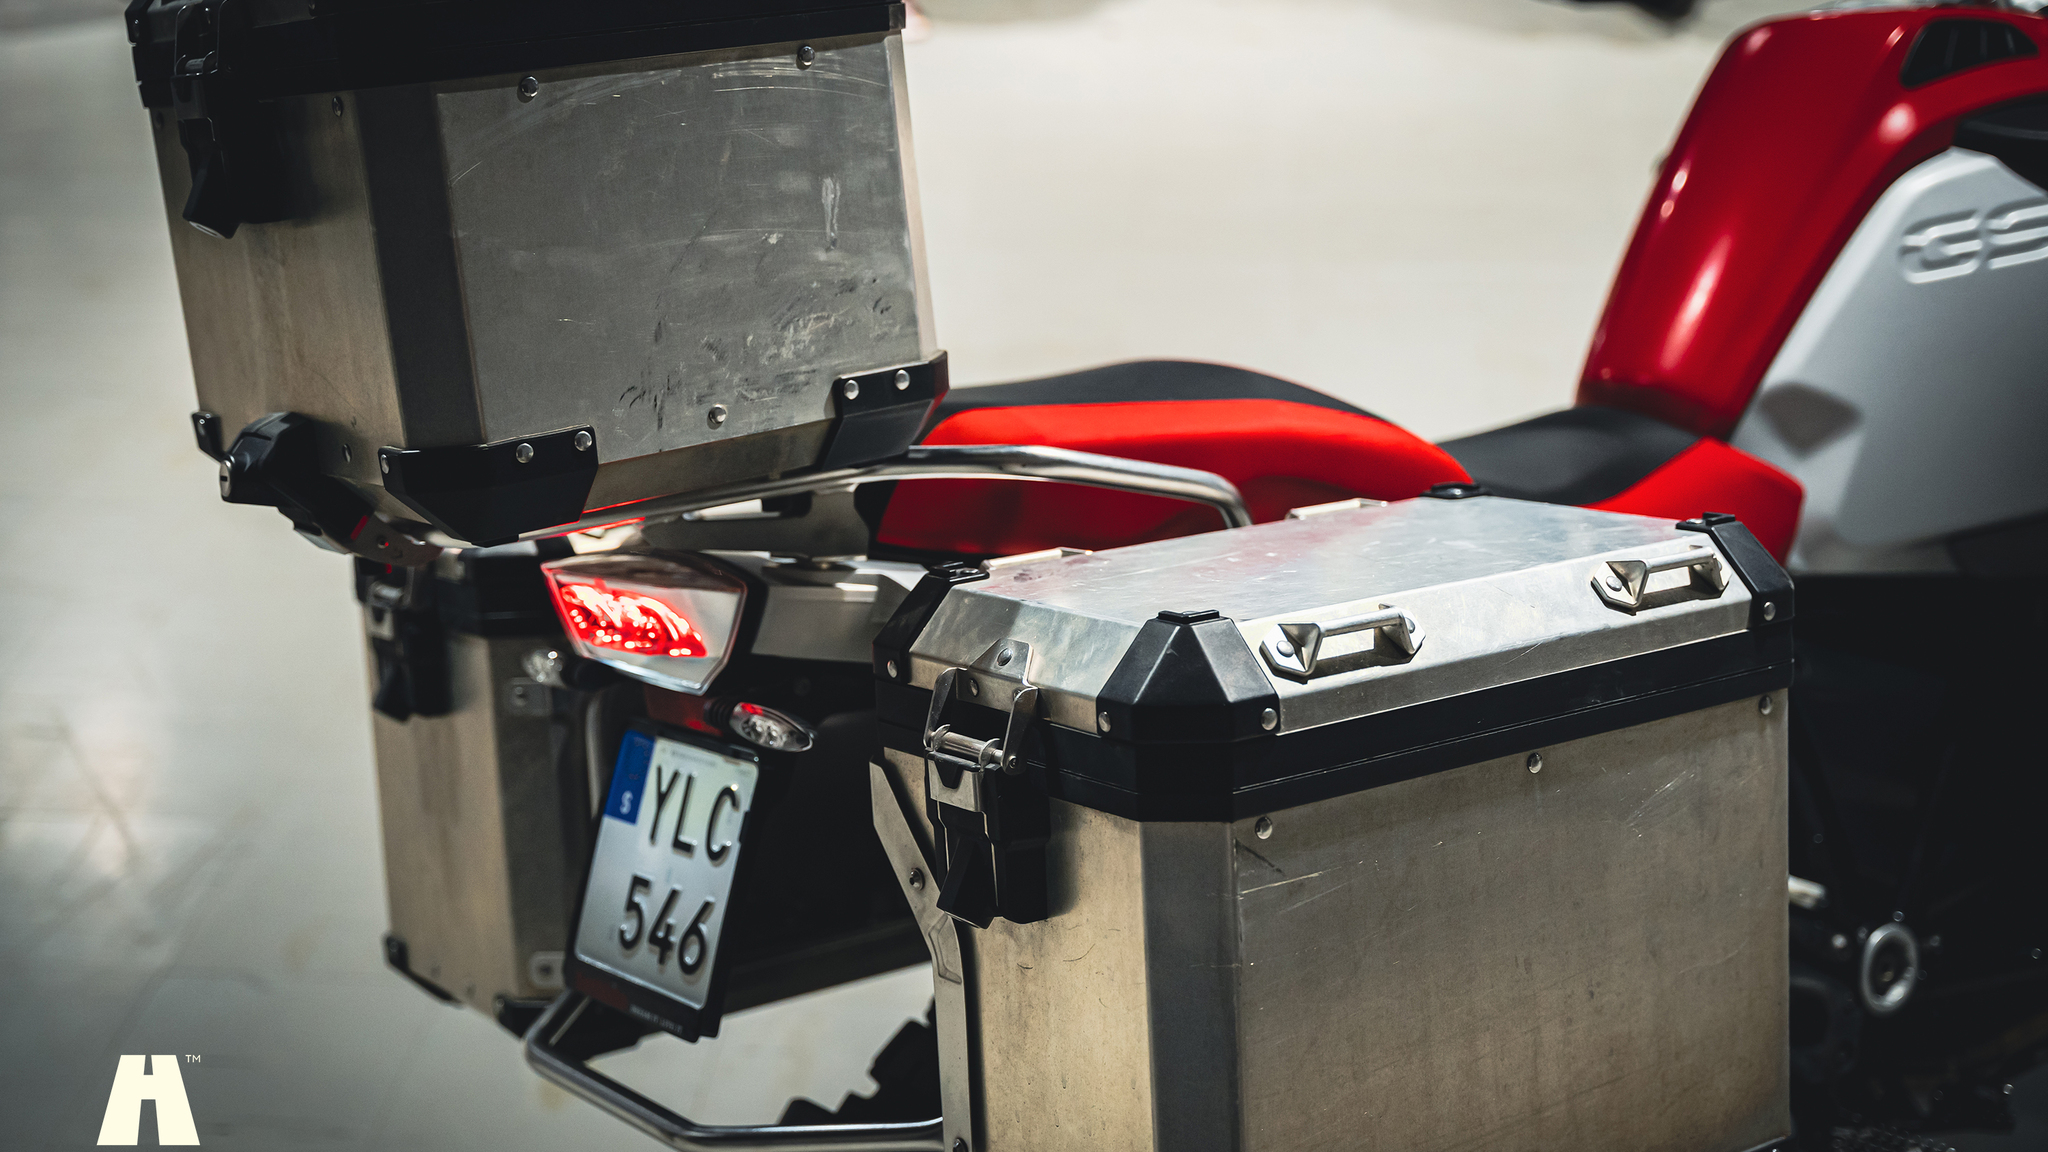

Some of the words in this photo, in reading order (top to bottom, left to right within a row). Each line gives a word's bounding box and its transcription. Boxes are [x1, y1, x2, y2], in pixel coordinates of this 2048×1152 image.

[1899, 197, 2048, 284] GS
[619, 790, 635, 815] S
[649, 764, 740, 868] YLC
[618, 873, 716, 976] 546
